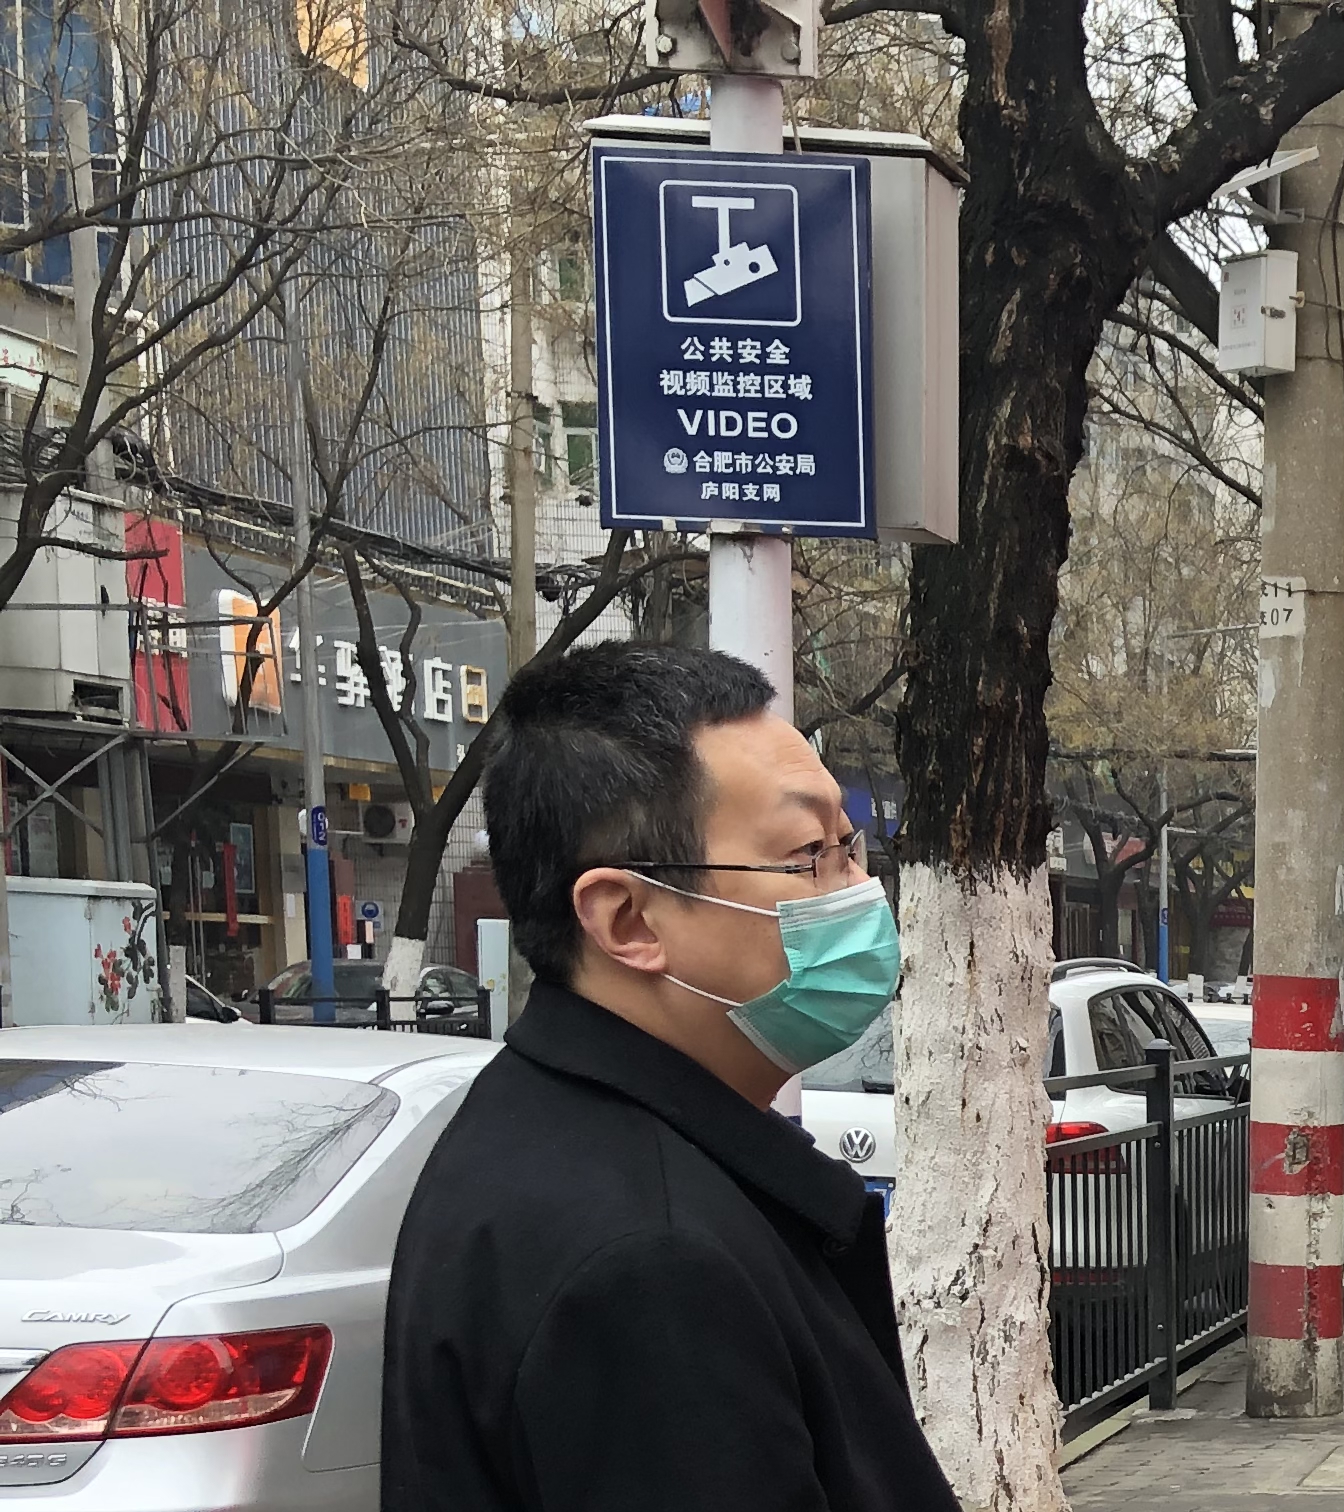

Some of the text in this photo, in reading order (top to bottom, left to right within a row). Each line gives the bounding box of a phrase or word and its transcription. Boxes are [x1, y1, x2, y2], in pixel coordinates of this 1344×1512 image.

[681, 336, 790, 365] 公共安全
[660, 370, 813, 400] 视频监控区域
[678, 409, 798, 439] VIDEO
[693, 450, 816, 476] 合肥市公安局
[701, 482, 780, 502] 庐阳支网
[21, 1309, 131, 1325] CAMRY
